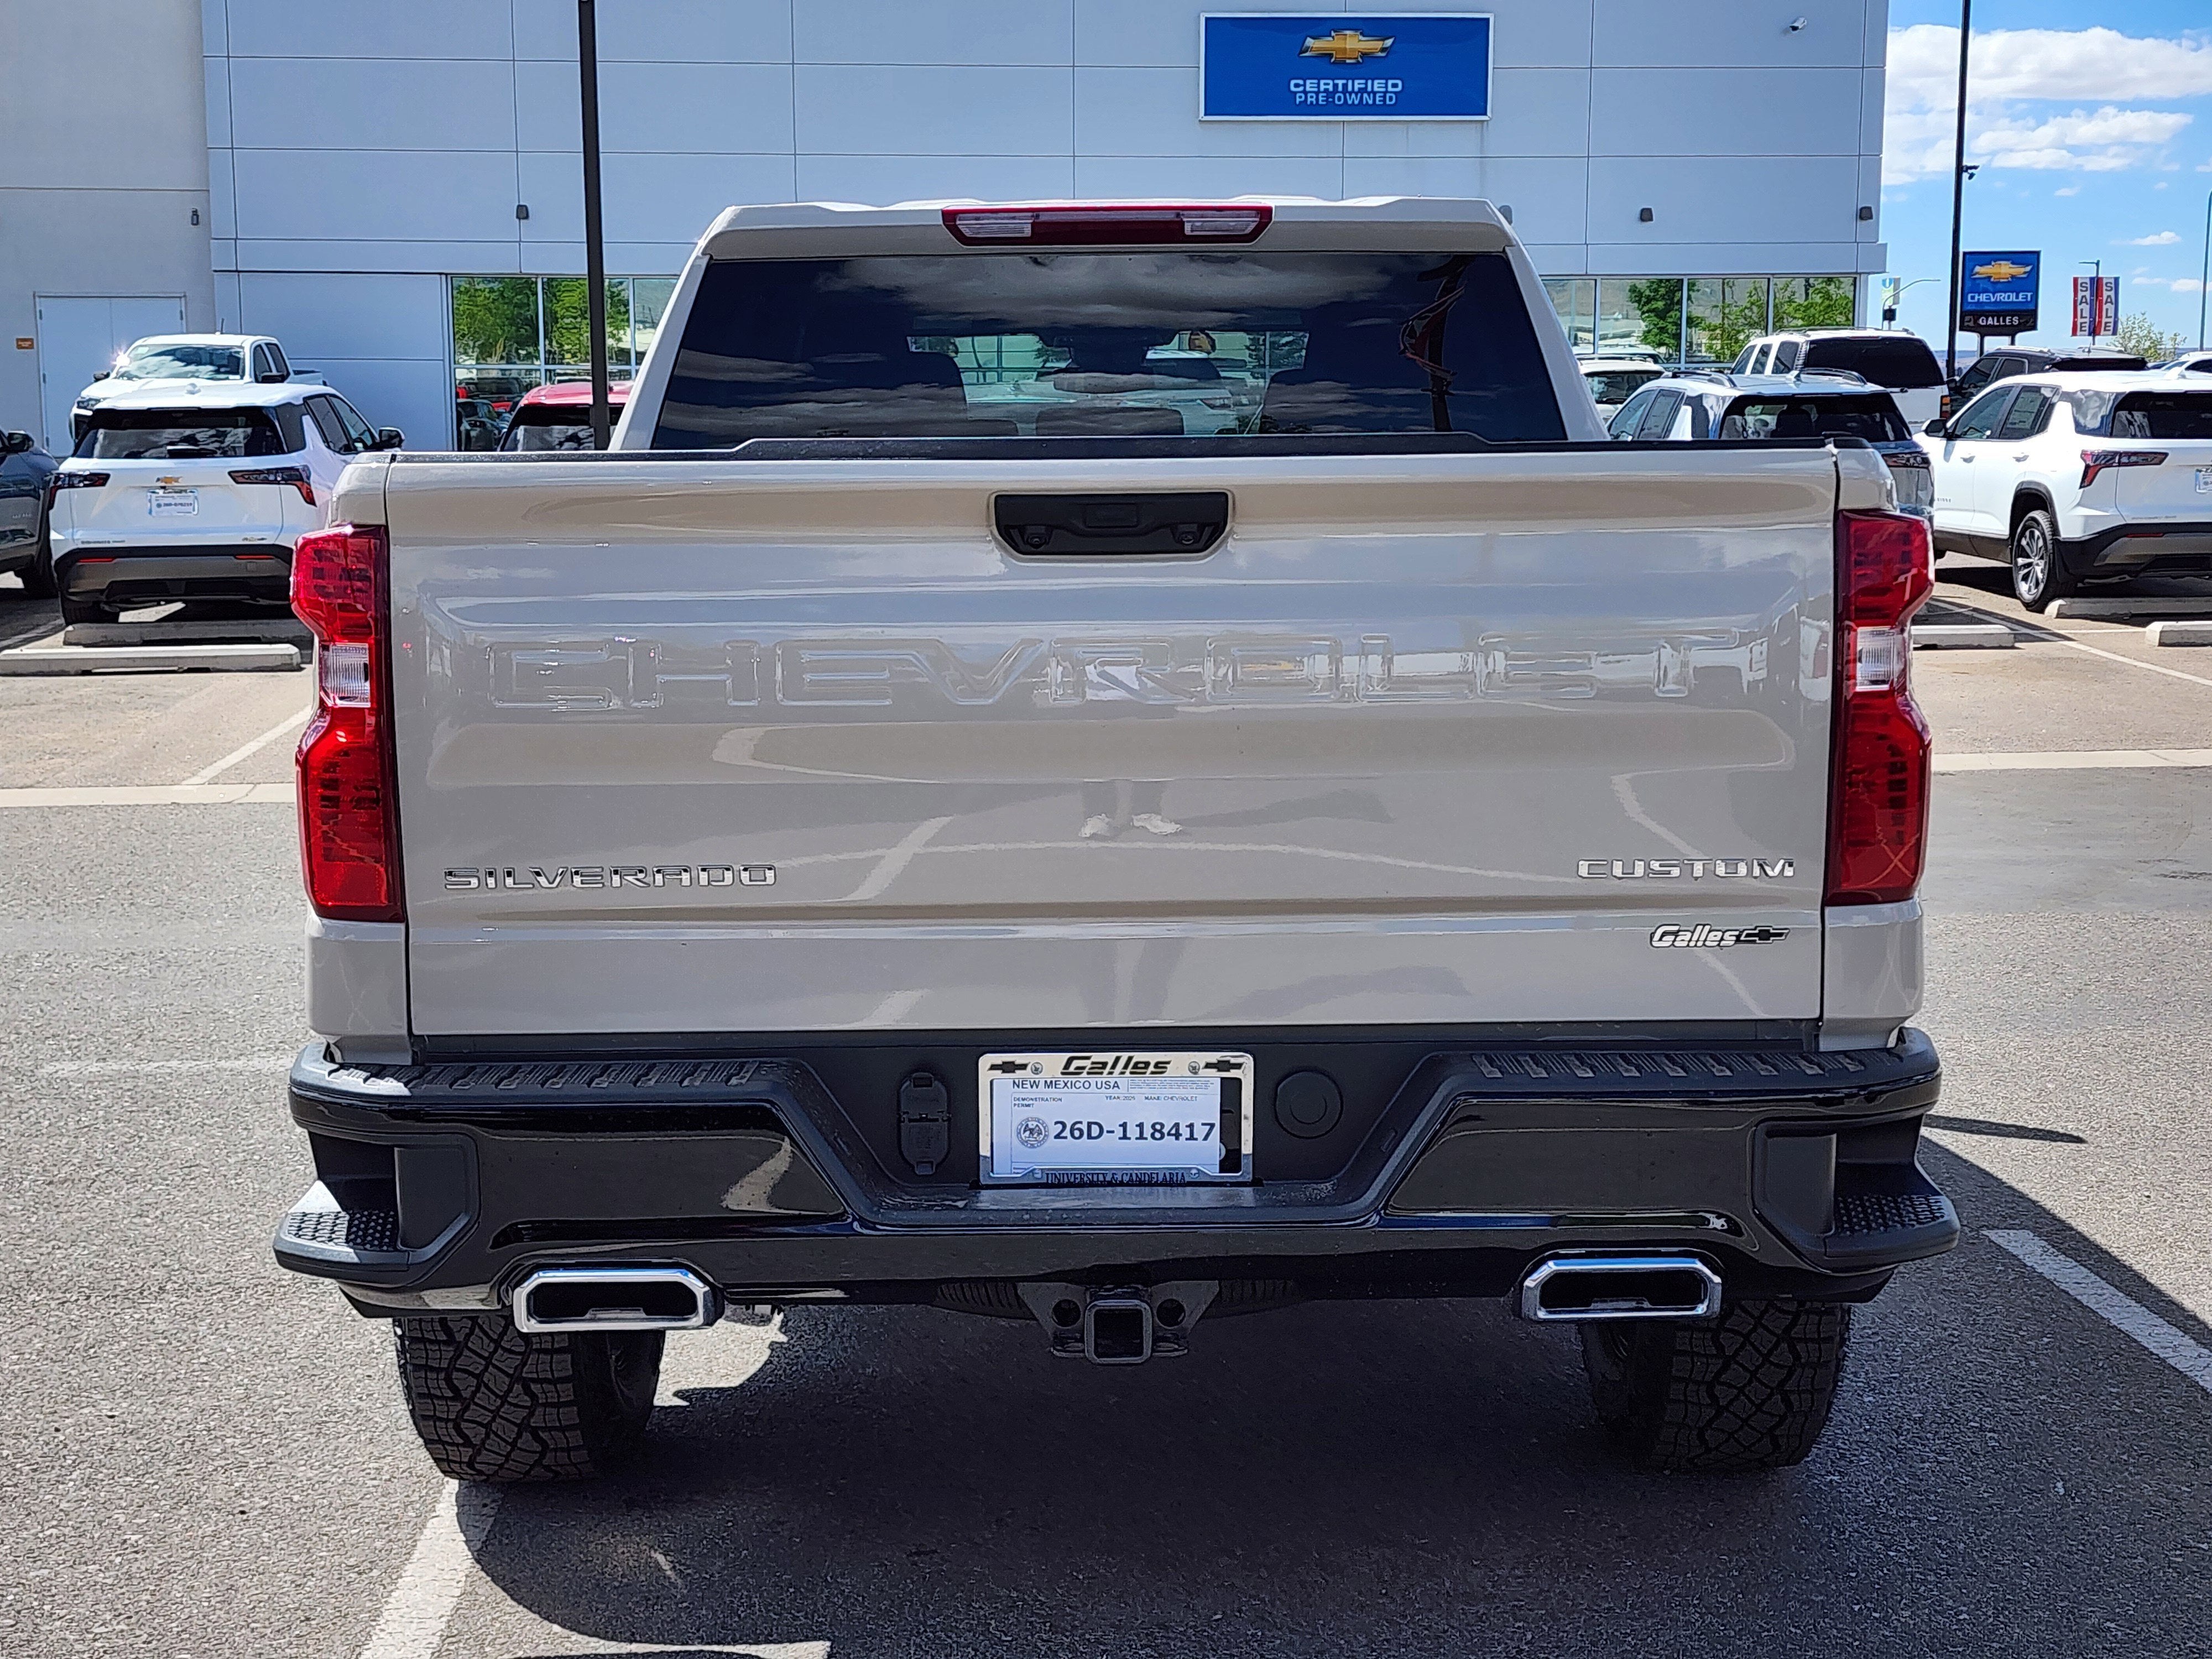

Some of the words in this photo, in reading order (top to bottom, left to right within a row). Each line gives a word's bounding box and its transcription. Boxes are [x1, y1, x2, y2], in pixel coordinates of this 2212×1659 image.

[1290, 79, 1402, 92] CERTIFIED
[1296, 93, 1396, 105] PRE-OWNED
[1968, 292, 2033, 302] CHEVROLET
[2079, 281, 2089, 332] SALE
[2104, 281, 2114, 332] SALE
[1979, 316, 2019, 325] GALLES
[444, 864, 777, 889] SILVERADO
[1577, 859, 1795, 878] CUSTOM
[1651, 924, 1741, 947] Galles
[1060, 1055, 1171, 1076] Galles
[1013, 1079, 1040, 1089] NEW
[1044, 1080, 1091, 1089] MEXICO
[1095, 1081, 1120, 1090] USA
[1053, 1120, 1215, 1141] 26D-118417
[1045, 1172, 1108, 1183] UNIVERSITY
[1110, 1172, 1119, 1183] &
